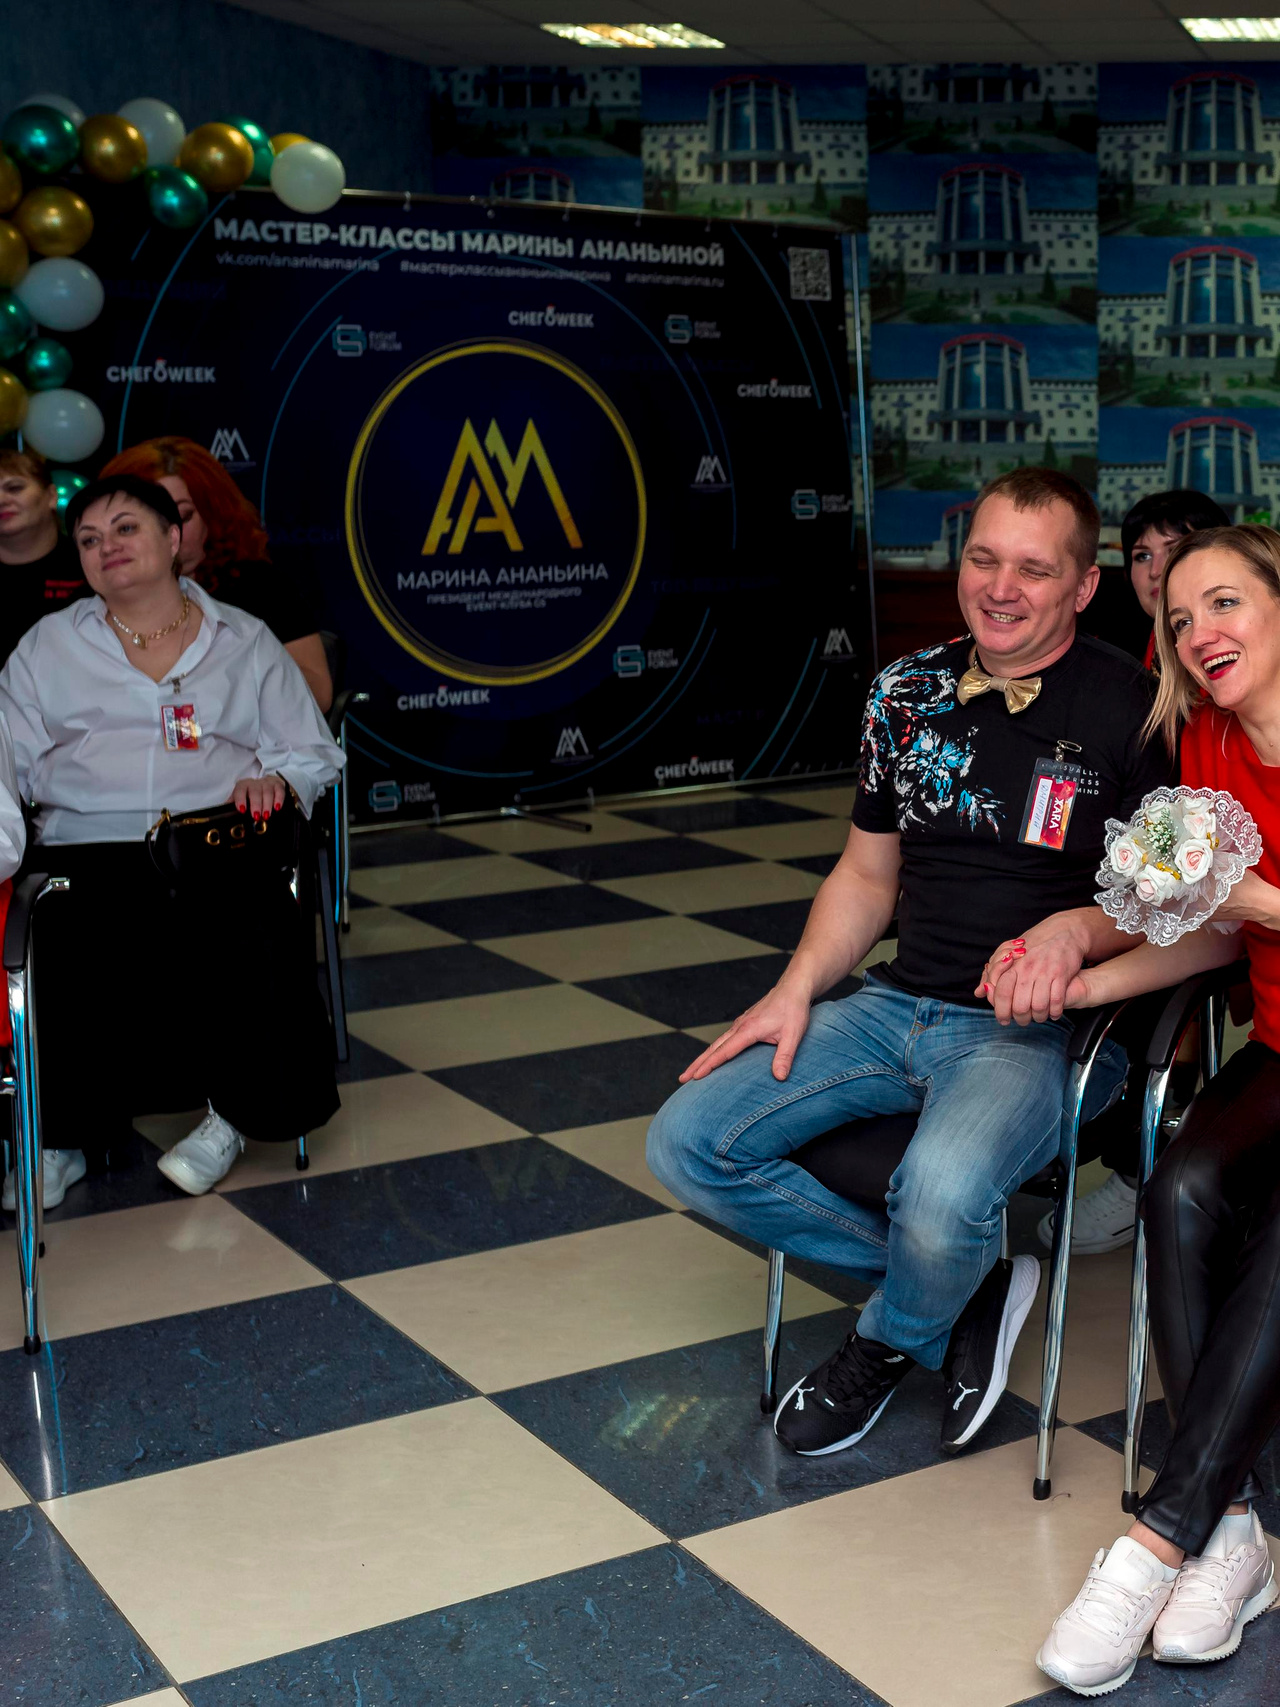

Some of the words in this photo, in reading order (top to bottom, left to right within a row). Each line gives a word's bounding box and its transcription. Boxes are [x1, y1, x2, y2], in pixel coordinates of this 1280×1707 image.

[213, 217, 455, 253] МАСТЕР-КЛАССЫ
[461, 231, 574, 258] МАРИНЫ
[579, 239, 725, 267] АНАНЬИНОЙ
[216, 251, 380, 272] vk.com/ananinamarina
[397, 568, 491, 590] МАРИНА
[496, 562, 609, 585] АНАНЬИНА
